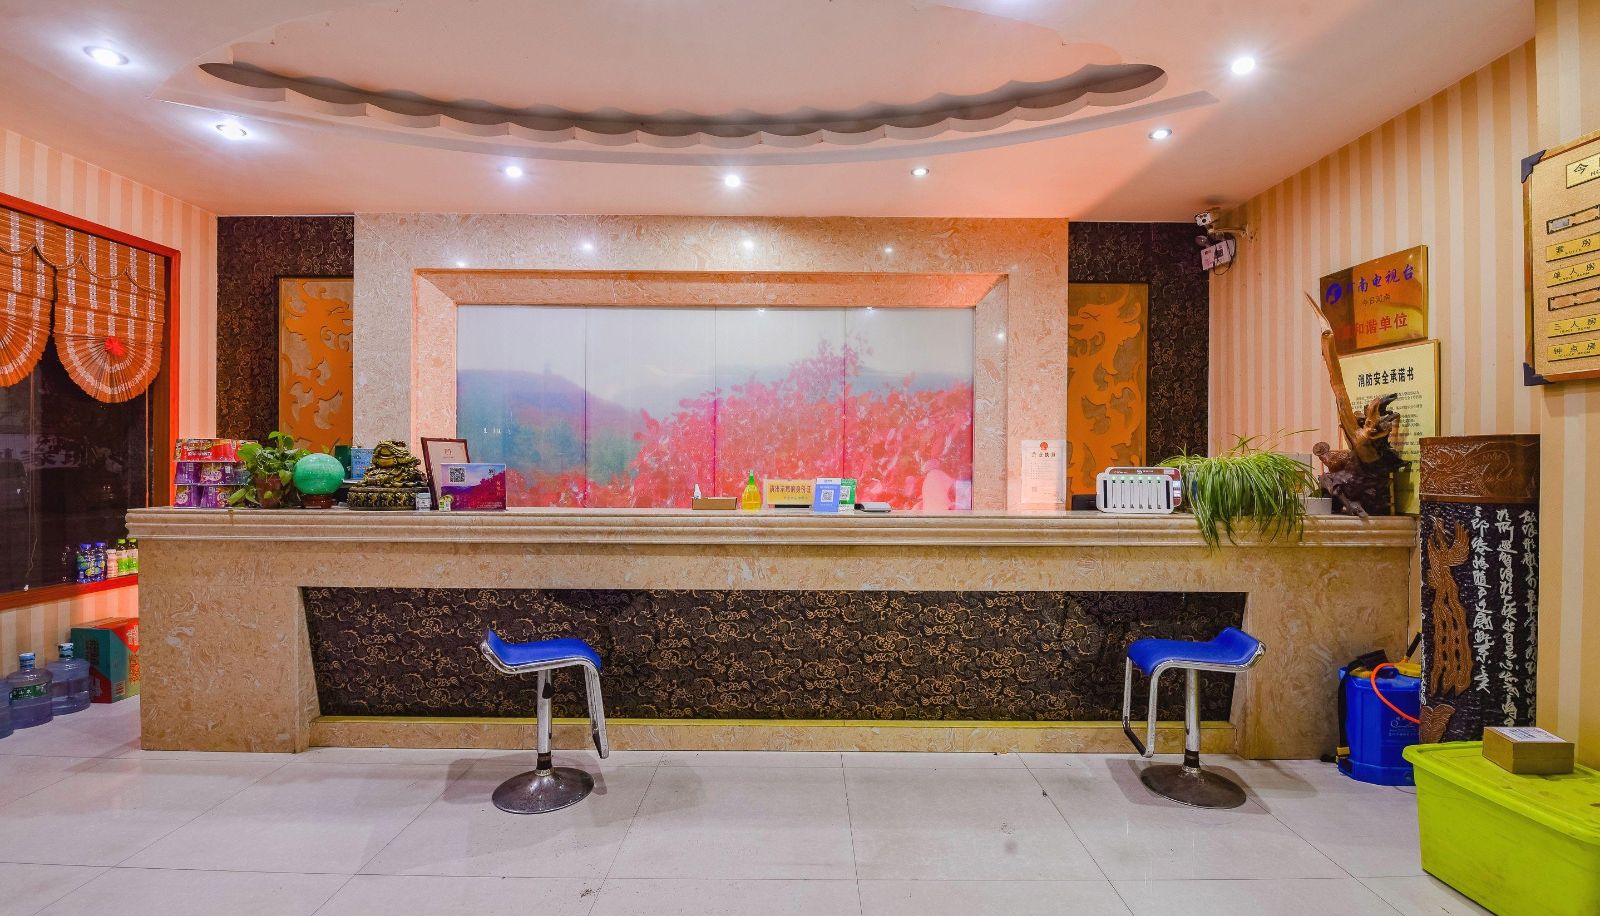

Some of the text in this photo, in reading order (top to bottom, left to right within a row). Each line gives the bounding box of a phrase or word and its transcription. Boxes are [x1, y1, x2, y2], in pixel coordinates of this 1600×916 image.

[1346, 263, 1415, 296] 南电视台
[1553, 262, 1596, 279] 单人房
[1553, 317, 1597, 331] 三人房
[1358, 366, 1415, 388] 消防安全承诺书
